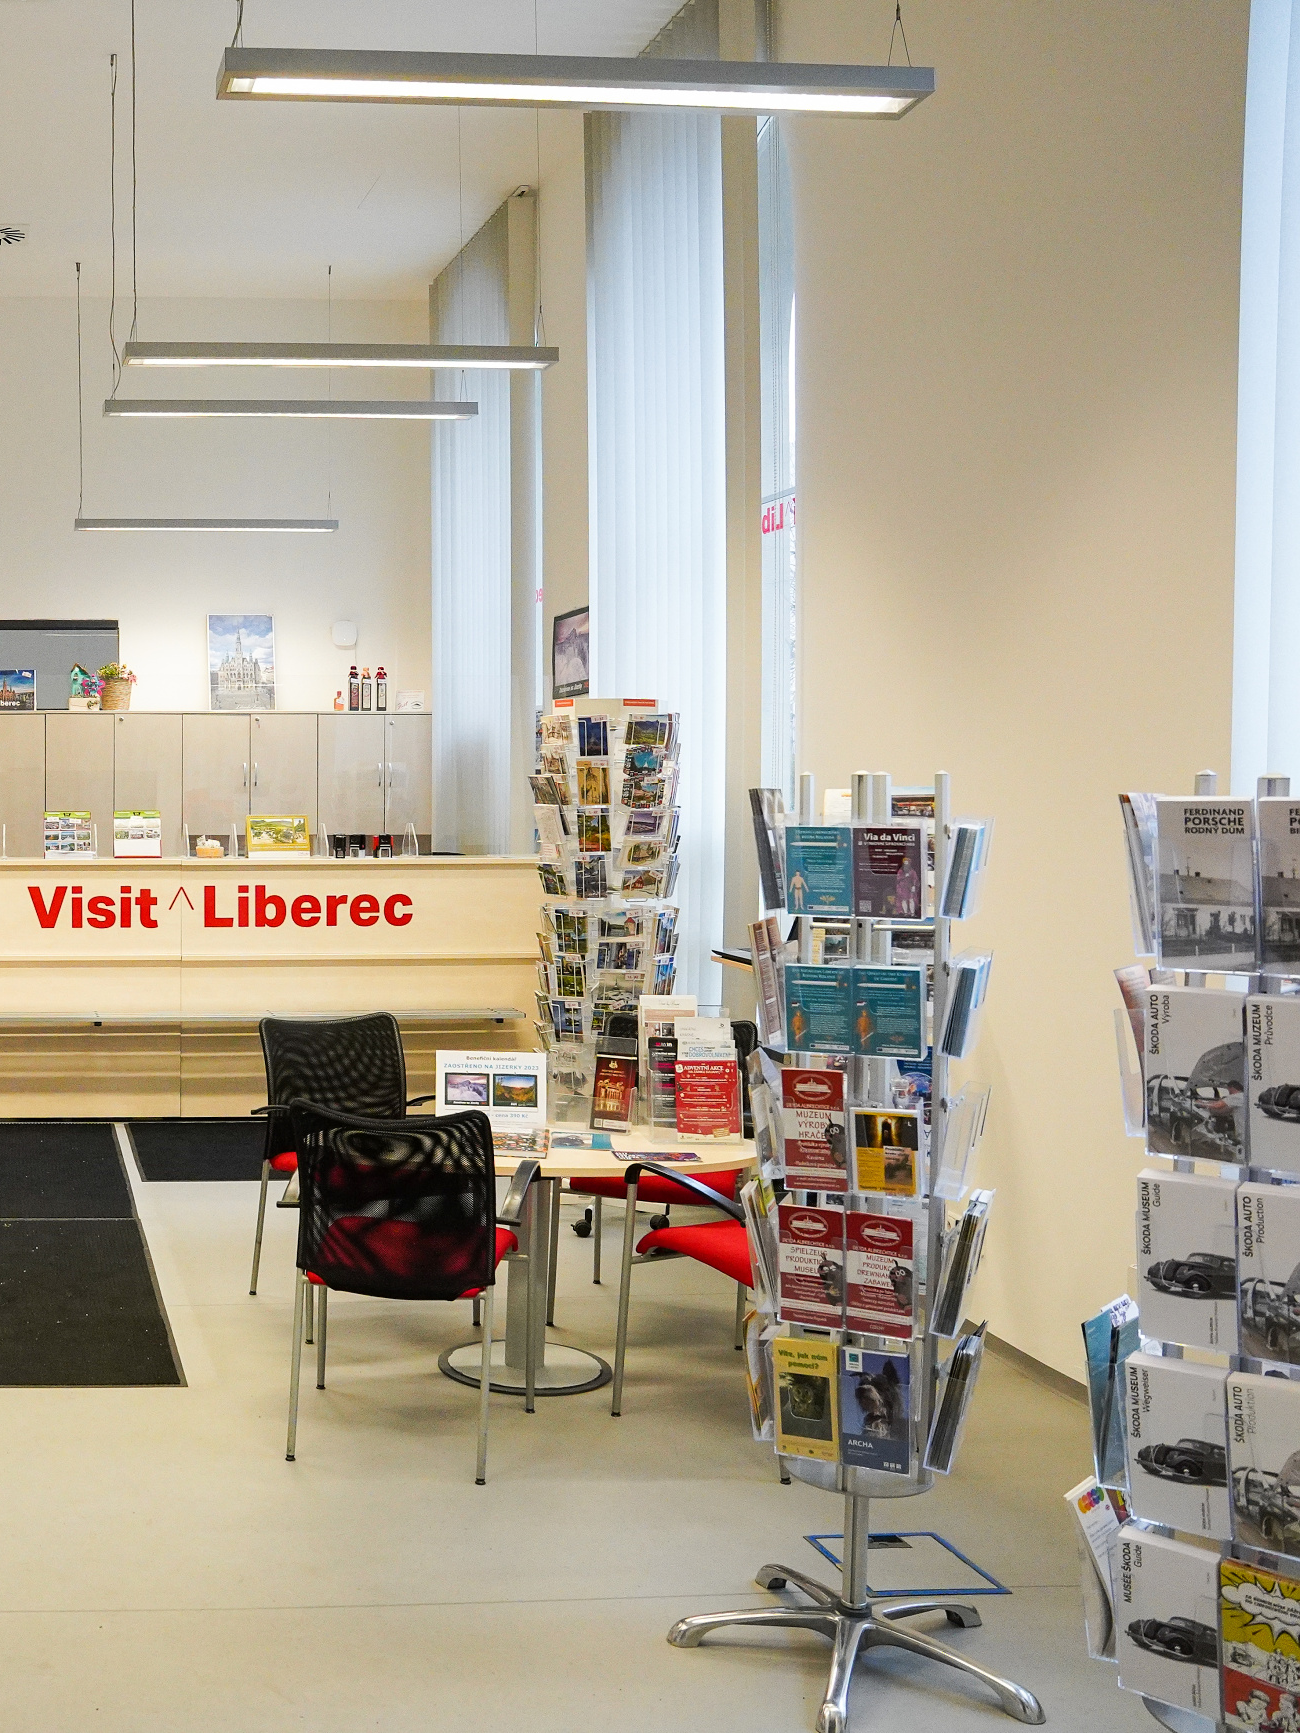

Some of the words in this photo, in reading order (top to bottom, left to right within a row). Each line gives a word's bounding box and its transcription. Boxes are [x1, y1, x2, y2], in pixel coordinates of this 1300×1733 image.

[1183, 808, 1244, 816] FERDINAND
[1184, 817, 1244, 826] PORSCHE
[863, 833, 878, 841] Via
[879, 833, 890, 841] da
[1184, 826, 1218, 835] RODNÝ
[1221, 826, 1245, 835] DŮM
[28, 885, 158, 929] Visit
[203, 884, 414, 928] Liberec
[1150, 994, 1159, 1020] AUTO
[1162, 995, 1170, 1024] Výroba
[1150, 1021, 1160, 1054] ŠKODA
[1252, 1004, 1262, 1046] MUZEUM
[1265, 1005, 1273, 1045] Průvodce
[1252, 1047, 1262, 1081] ŠKODA
[795, 1110, 832, 1119] MUZEUM
[798, 1129, 825, 1139] HRAČE
[1141, 1182, 1150, 1223] MUSEUM
[1153, 1183, 1161, 1207] Guide
[1242, 1196, 1252, 1222] AUTO
[1256, 1198, 1265, 1244] Production
[790, 1246, 828, 1257] SPIELZEUG
[1141, 1224, 1151, 1255] ŠKODA
[1242, 1223, 1253, 1257] ŠKODA
[794, 1265, 818, 1274] MUSEU
[862, 1262, 891, 1271] PRODUKC
[866, 1254, 894, 1264] MUZEUM
[857, 1269, 889, 1279] DREWNIAN
[797, 1351, 809, 1360] jak
[1129, 1367, 1139, 1406] MUSEUM
[1142, 1369, 1152, 1413] Wegweiser
[1233, 1386, 1242, 1411] AUTO
[1131, 1407, 1141, 1438] ŠKODA
[1247, 1388, 1257, 1435] Produktion
[1234, 1412, 1245, 1443] ŠKODA
[847, 1439, 874, 1449] ARCHA
[1120, 1542, 1131, 1572] ŠKODA
[1133, 1544, 1142, 1568] Guide
[1121, 1571, 1132, 1604] MUSÉE
